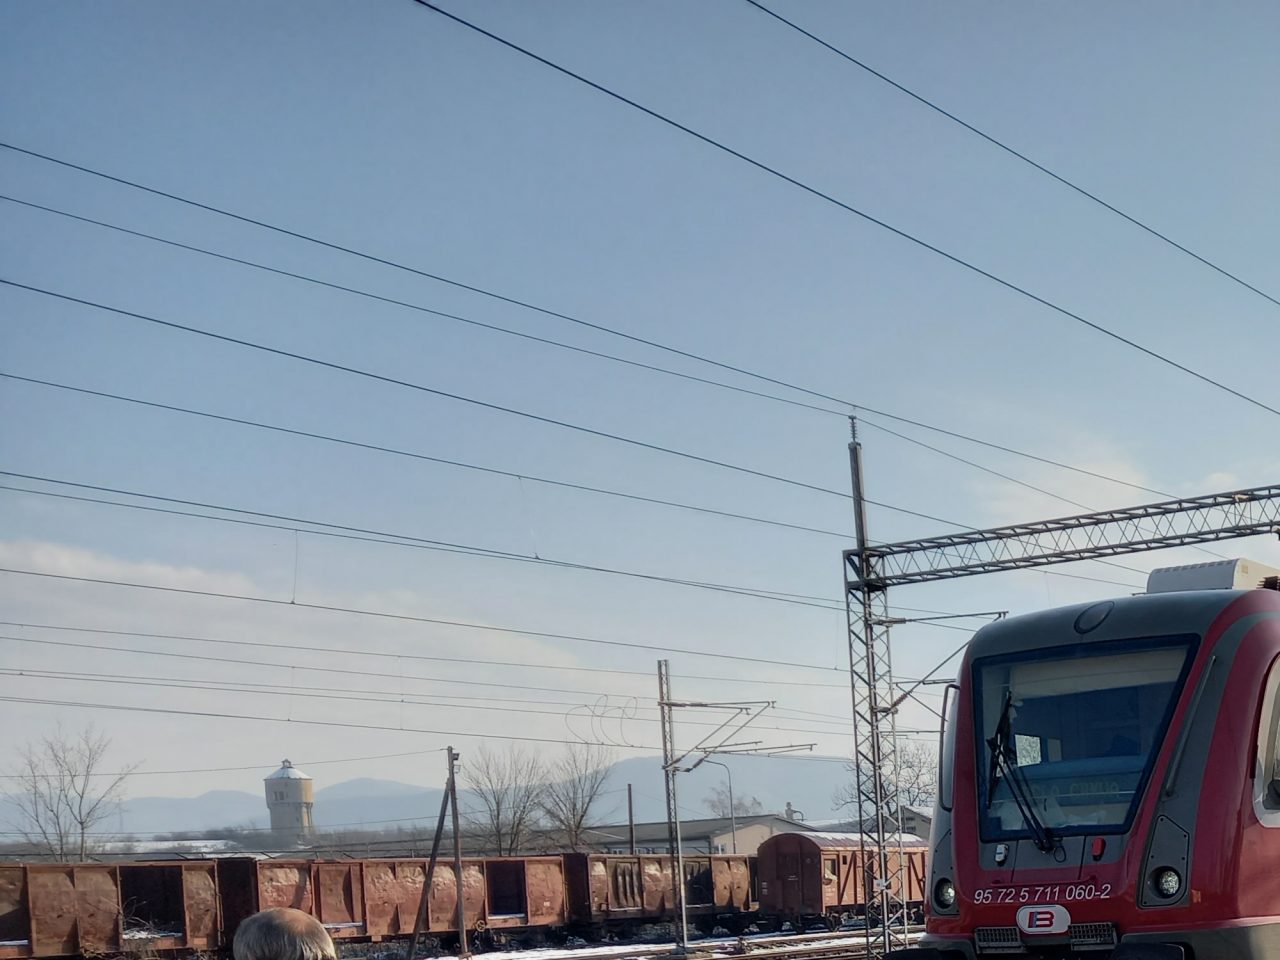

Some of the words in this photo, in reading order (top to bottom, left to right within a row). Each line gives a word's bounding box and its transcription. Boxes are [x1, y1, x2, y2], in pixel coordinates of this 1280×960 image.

[974, 889, 992, 904] 95
[997, 888, 1015, 903] 72
[1019, 887, 1029, 902] 5
[1034, 886, 1060, 901] 711
[1065, 884, 1111, 900] 060-2
